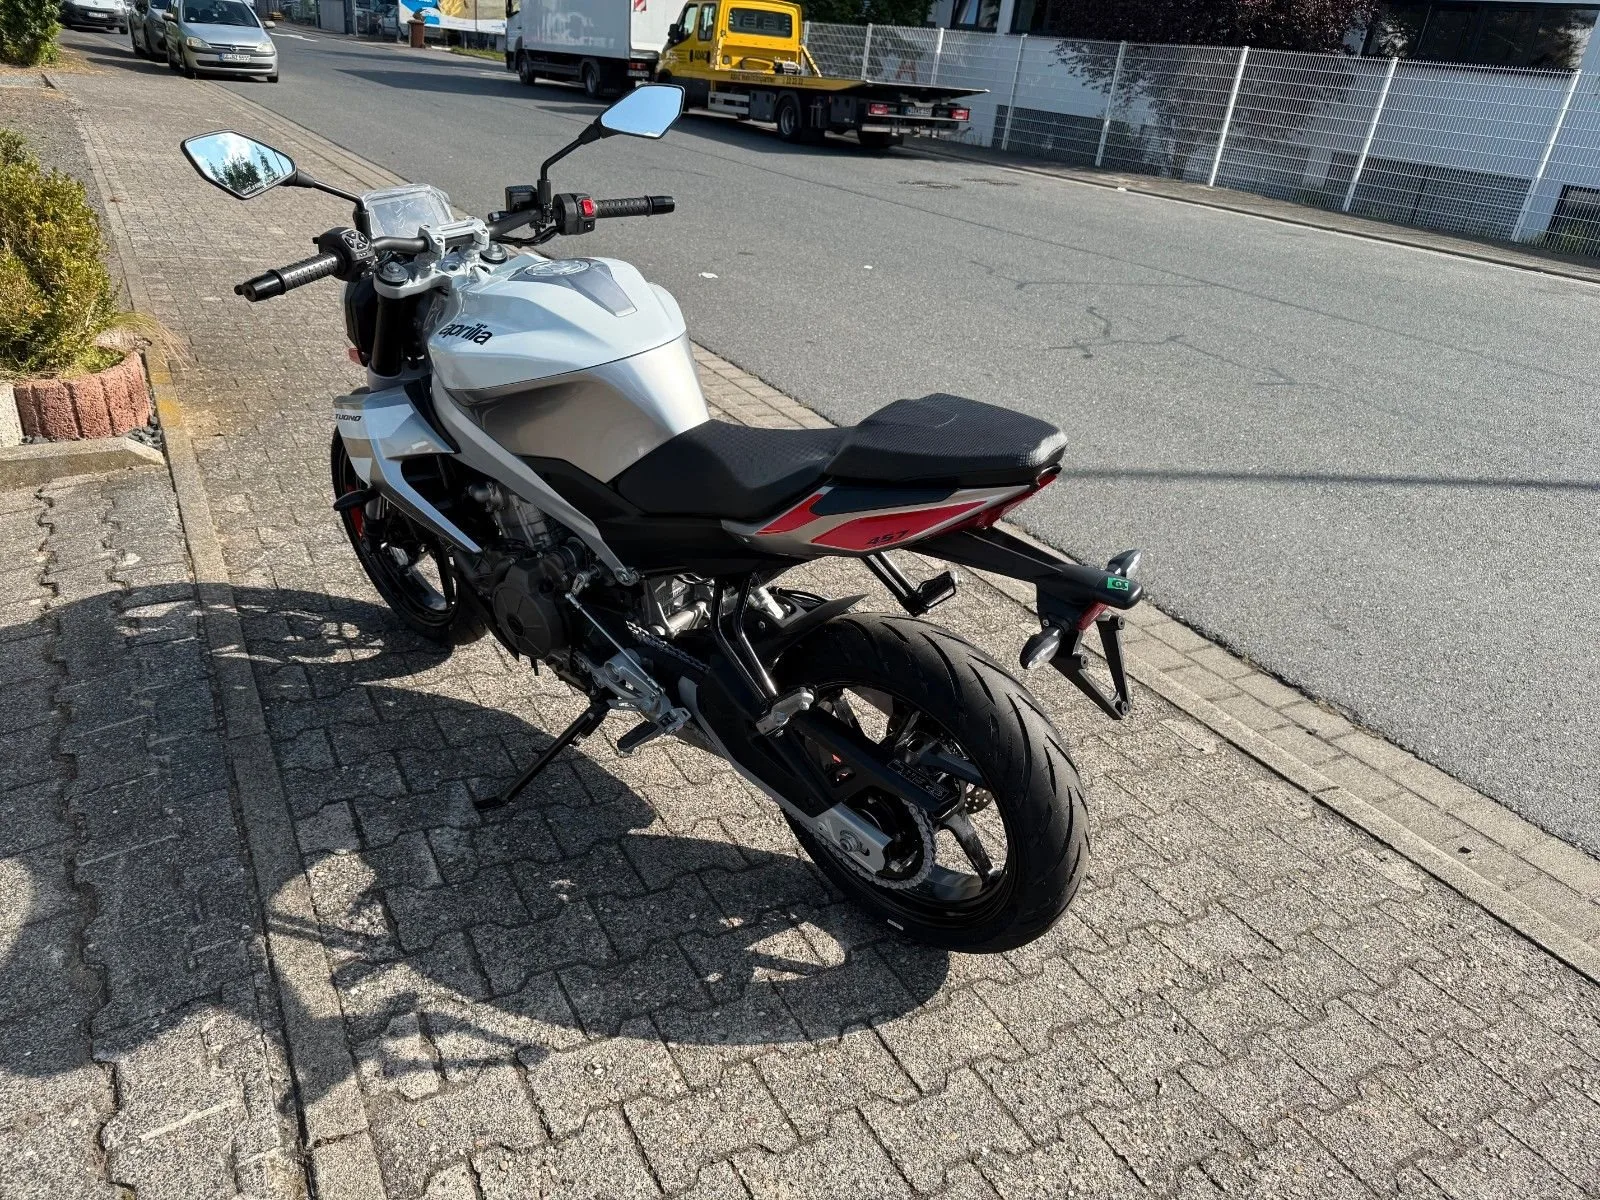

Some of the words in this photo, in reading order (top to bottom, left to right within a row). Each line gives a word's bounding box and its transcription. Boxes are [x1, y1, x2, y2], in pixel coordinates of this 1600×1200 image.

[438, 323, 493, 345] aprilia
[335, 414, 362, 422] TUONO
[866, 529, 910, 547] 457
